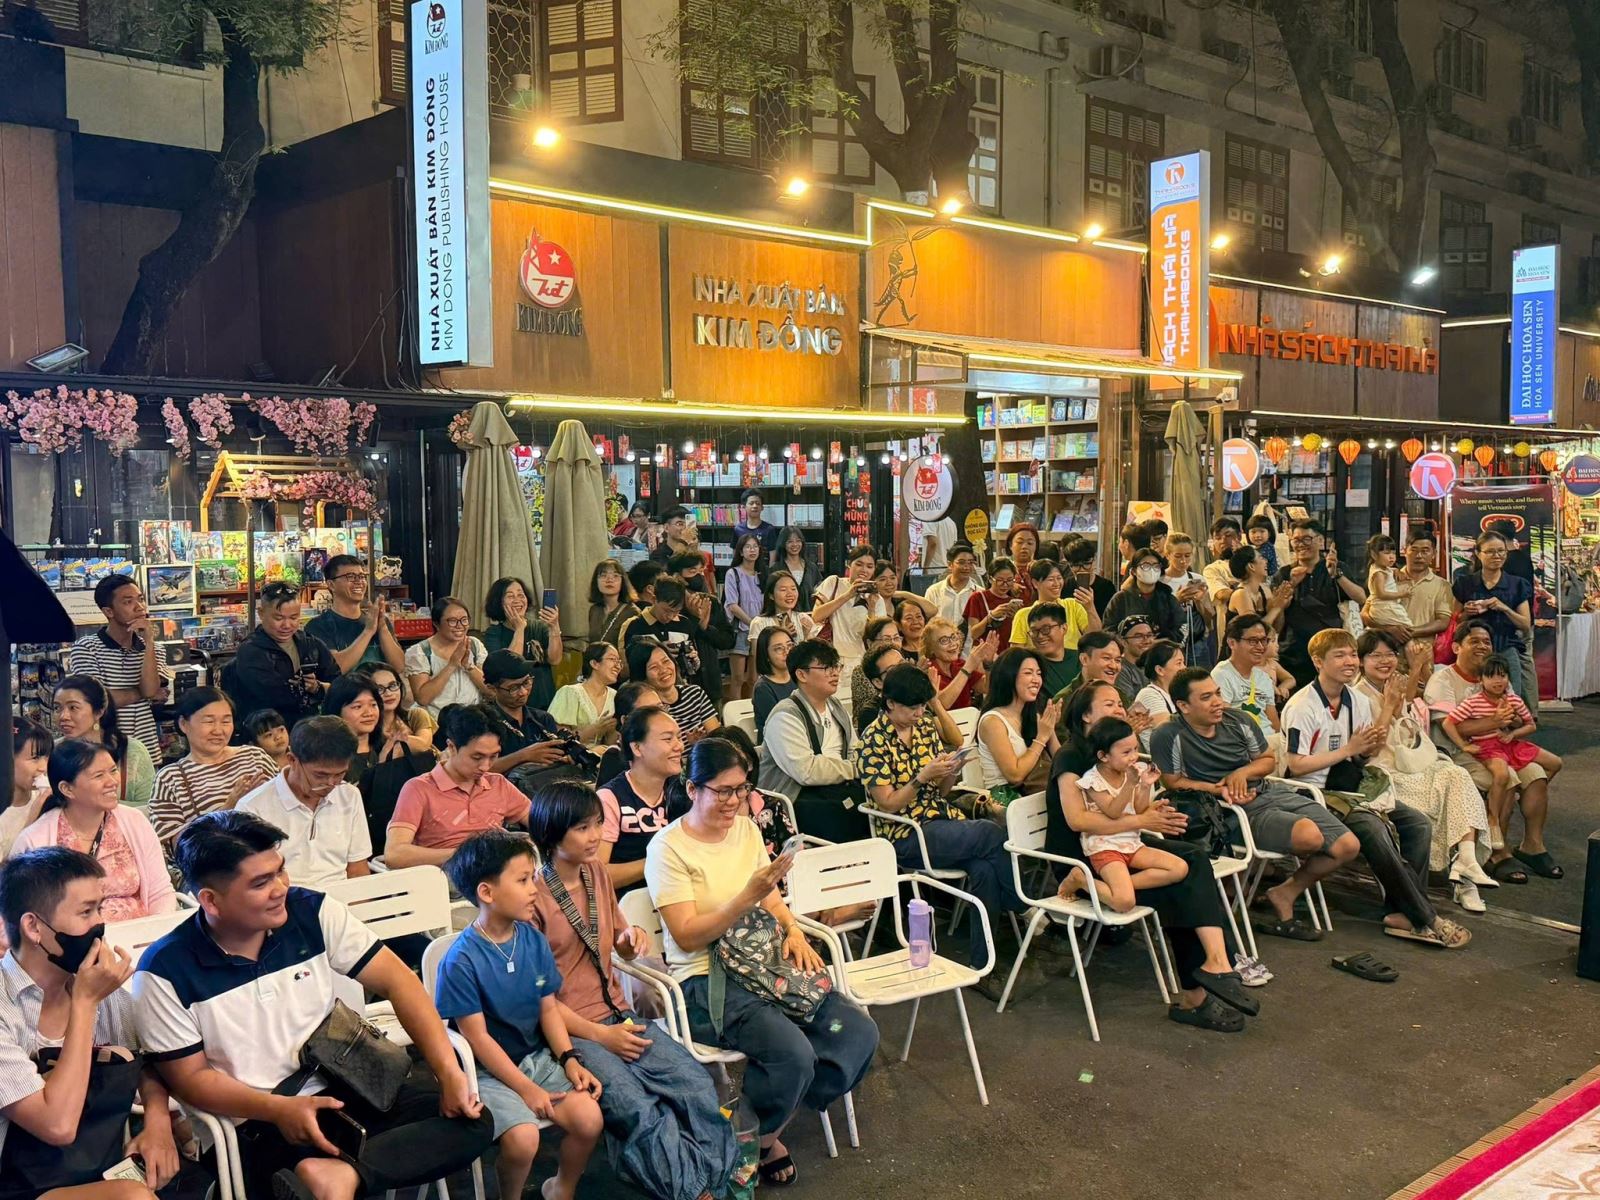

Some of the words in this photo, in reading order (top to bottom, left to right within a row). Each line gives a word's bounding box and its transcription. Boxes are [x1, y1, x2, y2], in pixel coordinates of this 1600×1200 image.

[423, 77, 436, 143] ĐỒNG
[439, 72, 449, 135] HOUSE
[427, 149, 436, 189] KIM
[440, 140, 452, 246] PUBLISHING
[425, 196, 438, 239] BẢN
[1161, 213, 1177, 249] HÀ
[426, 247, 439, 300] XUẤT
[442, 252, 453, 312] DONG
[1161, 254, 1177, 307] THÁI
[1180, 229, 1191, 357] THAIHABOOKS
[429, 304, 440, 351] NHÀ
[516, 302, 545, 333] KIM
[695, 313, 753, 349] KIM
[756, 310, 843, 356] ĐỒNG
[1523, 300, 1533, 324] SEN
[1535, 299, 1544, 360] UNIVERSITY
[444, 318, 453, 350] KIM
[1522, 326, 1533, 353] HOA
[1535, 364, 1543, 383] SEN
[1535, 386, 1543, 408] HOA
[913, 499, 925, 511] KIM
[850, 522, 869, 534] NĂM
